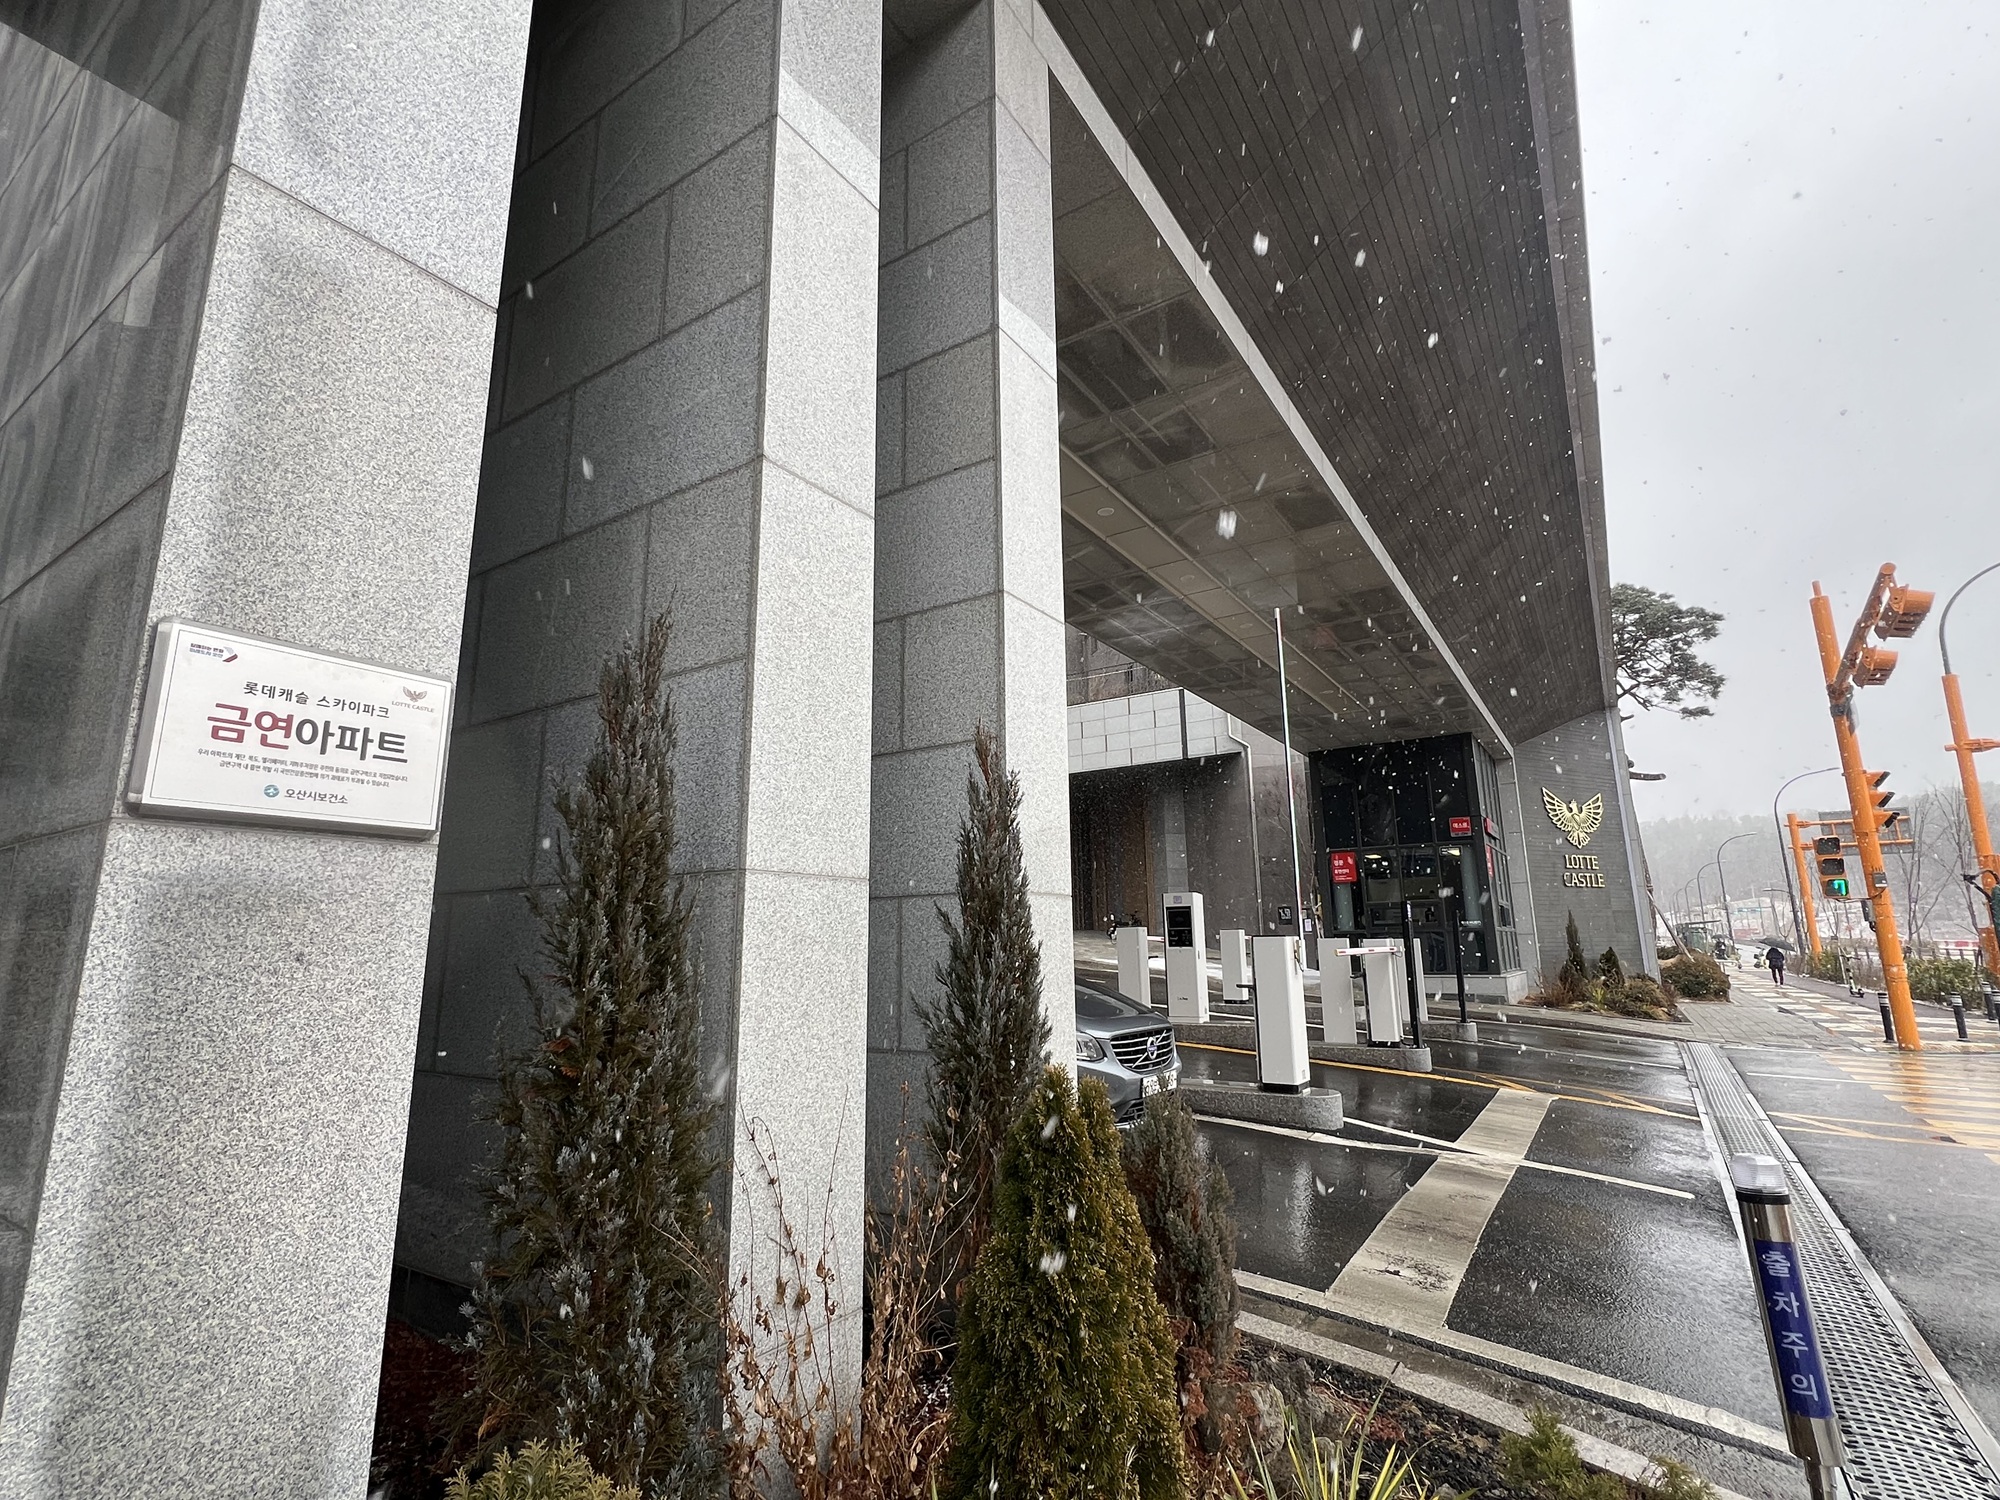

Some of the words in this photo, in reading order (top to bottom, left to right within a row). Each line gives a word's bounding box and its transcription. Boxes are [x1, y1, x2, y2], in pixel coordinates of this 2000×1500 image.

[243, 680, 310, 706] 롯데캐슬
[316, 694, 391, 719] 스카이파크
[391, 700, 411, 709] LOTTE
[411, 704, 435, 713] CASTLE
[206, 702, 409, 764] 금연아파트
[283, 787, 349, 805] 오산시보건소
[1564, 853, 1600, 870] LOTTE
[1563, 872, 1606, 888] CASTLE
[1763, 1250, 1819, 1402] 출차주의
